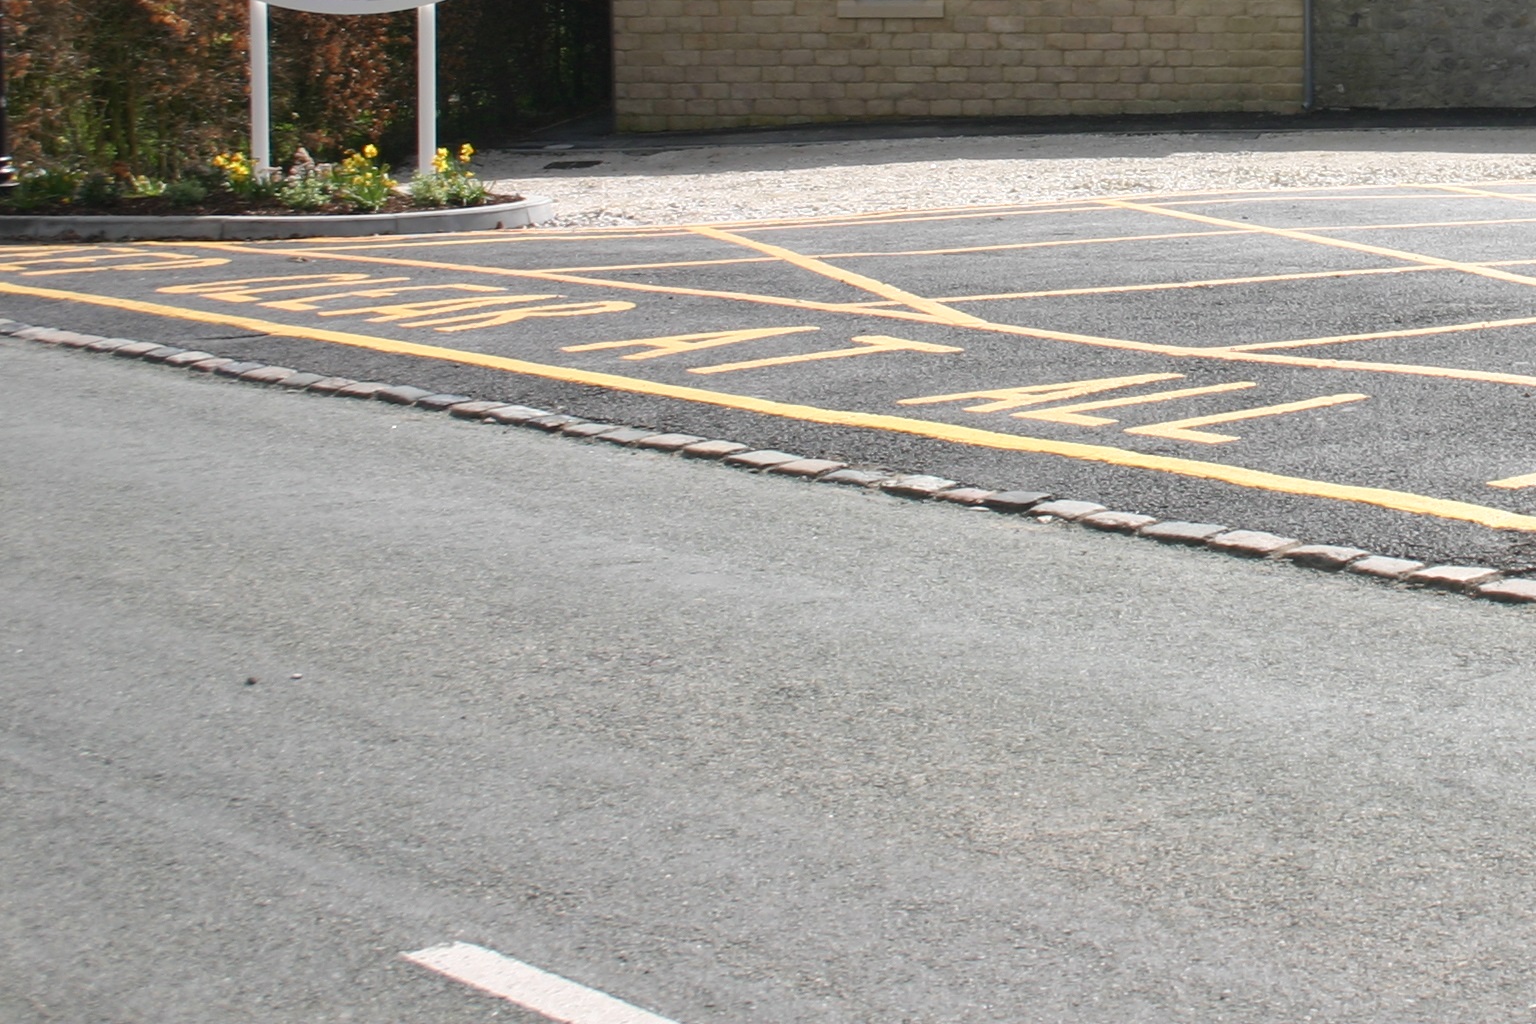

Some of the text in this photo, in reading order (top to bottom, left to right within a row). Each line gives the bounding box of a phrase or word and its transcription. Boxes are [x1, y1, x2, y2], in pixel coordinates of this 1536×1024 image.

[155, 273, 637, 332] CLEAR
[560, 326, 965, 374] AT
[896, 372, 1371, 445] ALL
